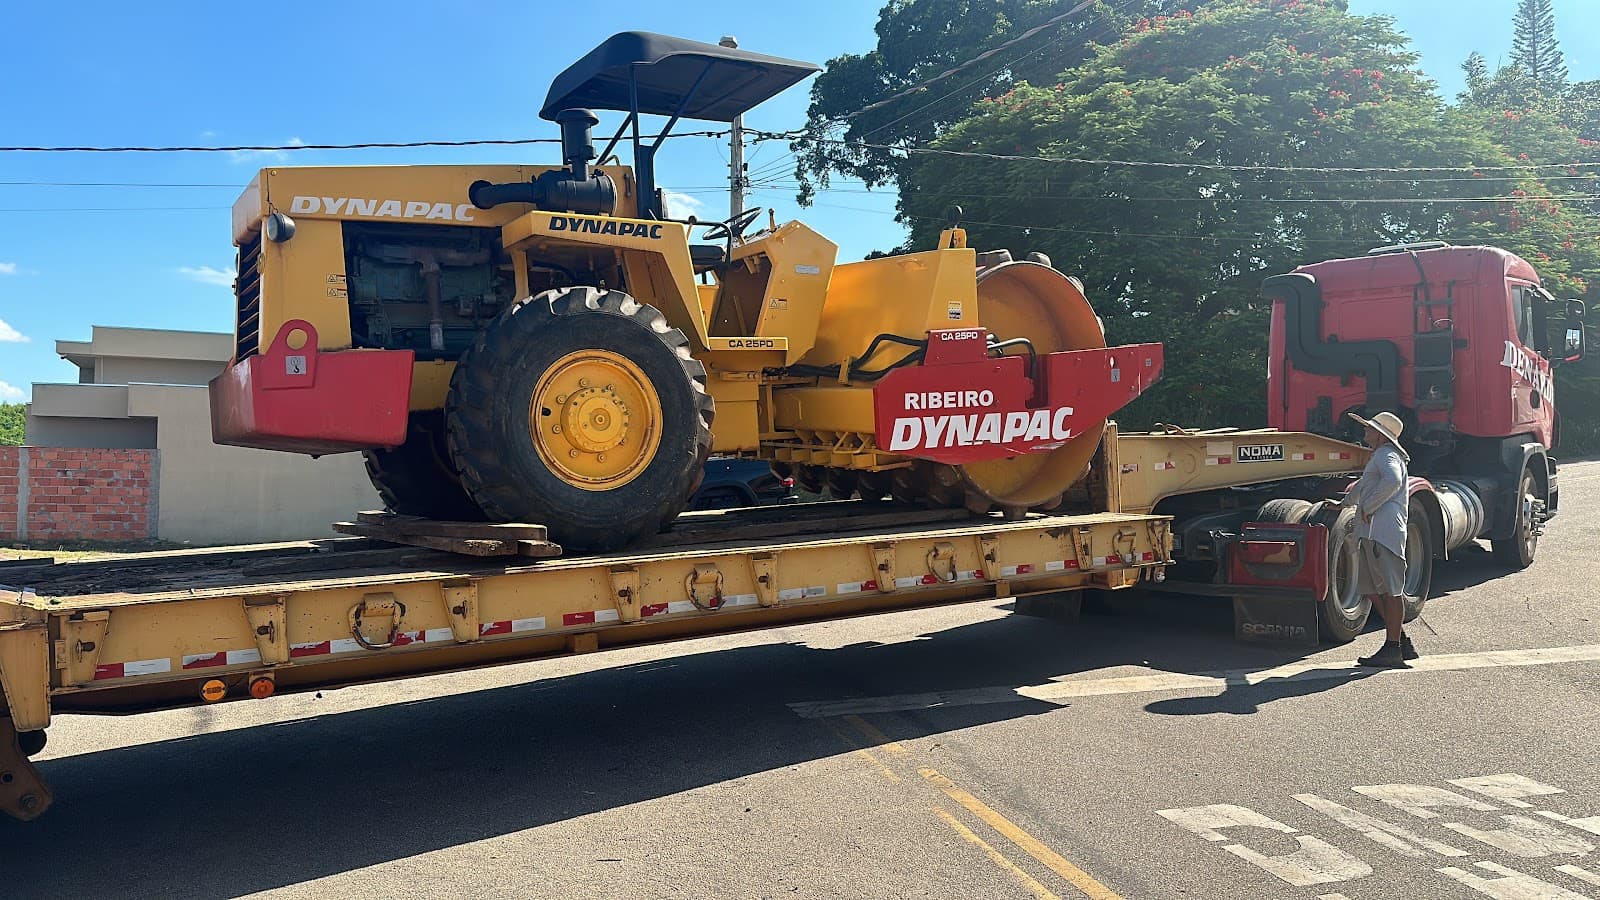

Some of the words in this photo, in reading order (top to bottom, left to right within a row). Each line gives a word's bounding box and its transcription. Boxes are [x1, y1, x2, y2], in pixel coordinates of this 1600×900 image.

[290, 196, 474, 222] DYNAPAC
[549, 216, 663, 239] DYNAPAC
[728, 339, 744, 348] CA
[745, 339, 774, 348] 25PD
[941, 332, 954, 341] CA
[955, 331, 978, 340] 25PD
[904, 389, 994, 410] RIBEIRO
[889, 406, 1074, 451] DYNAPAC
[1240, 446, 1281, 457] NOMA
